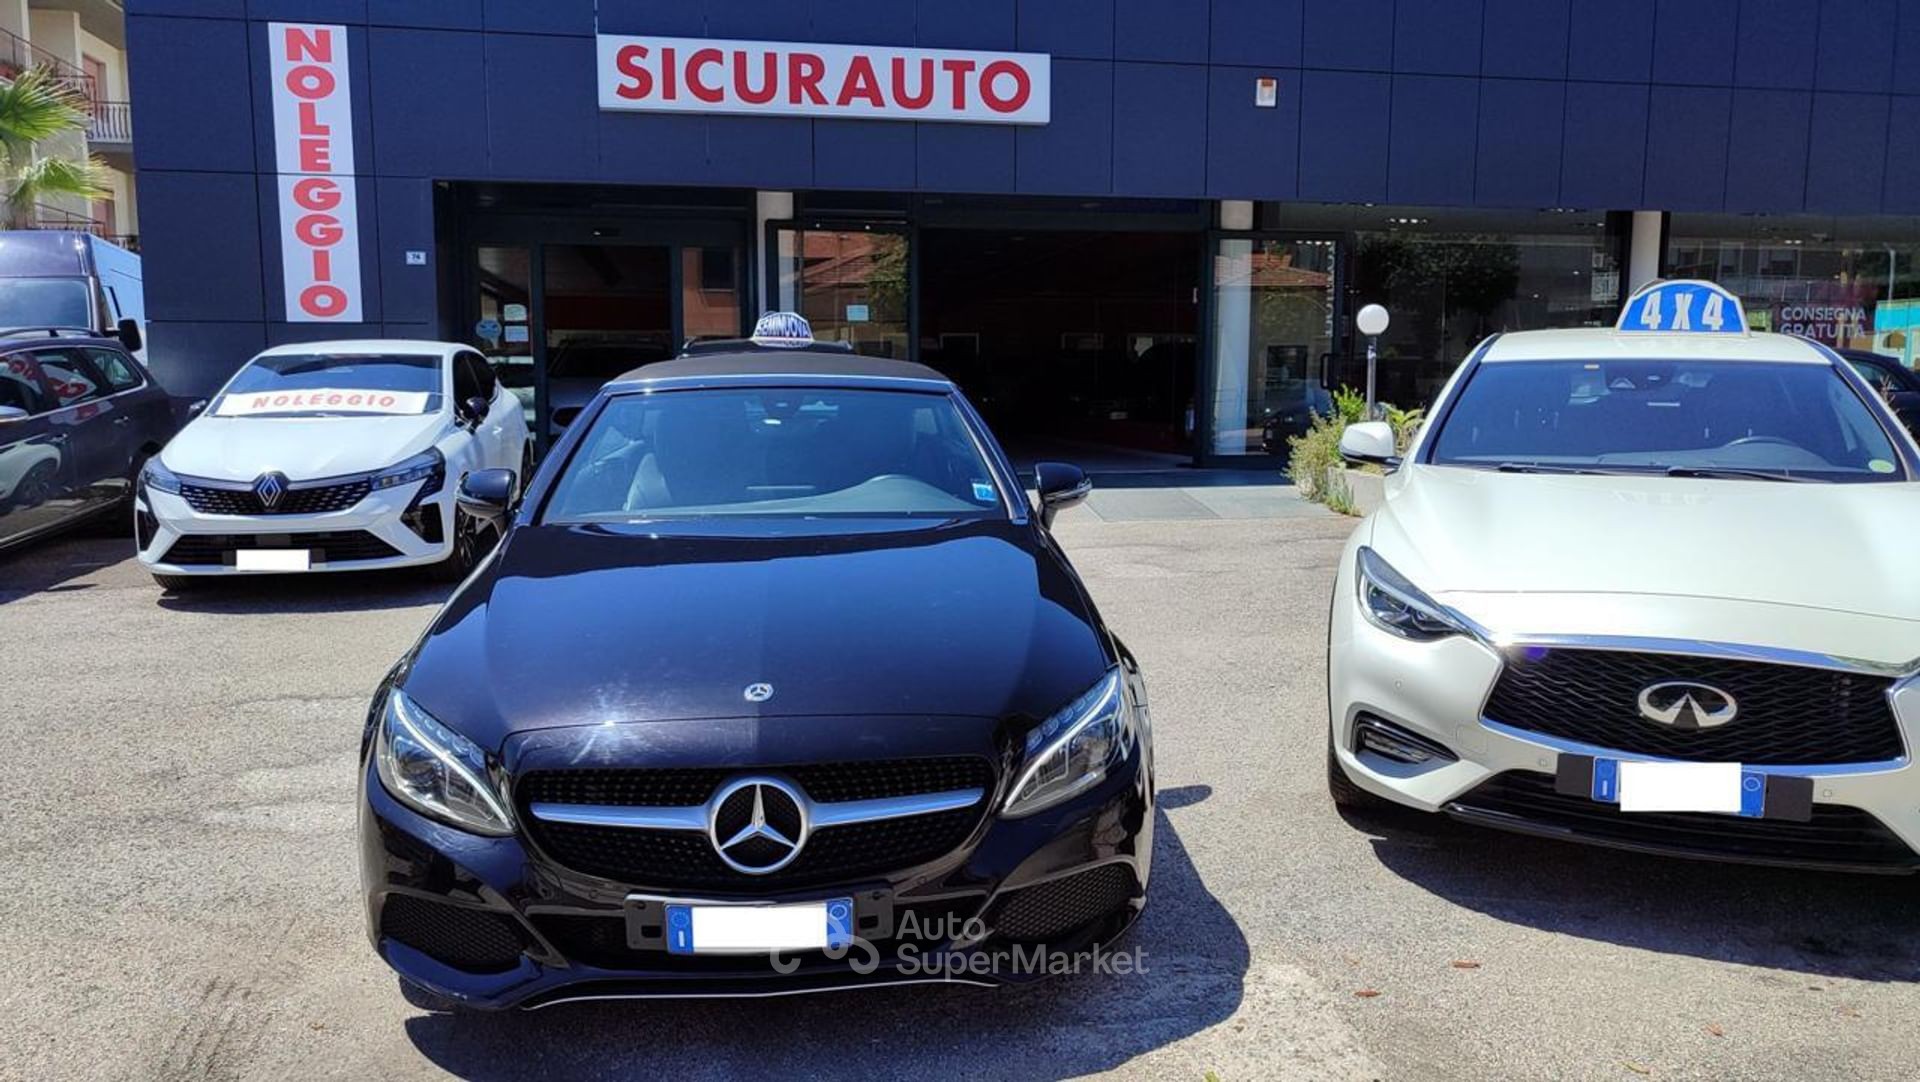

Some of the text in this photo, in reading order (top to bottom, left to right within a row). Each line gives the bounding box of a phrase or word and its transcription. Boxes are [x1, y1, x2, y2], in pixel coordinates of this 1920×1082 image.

[616, 44, 1031, 113] SICURAUTO
[285, 28, 348, 317] NOLEGGIO
[1780, 306, 1867, 321] CONSEGNA
[1780, 322, 1866, 339] GRATUITA
[252, 394, 396, 409] NOLEGGIO
